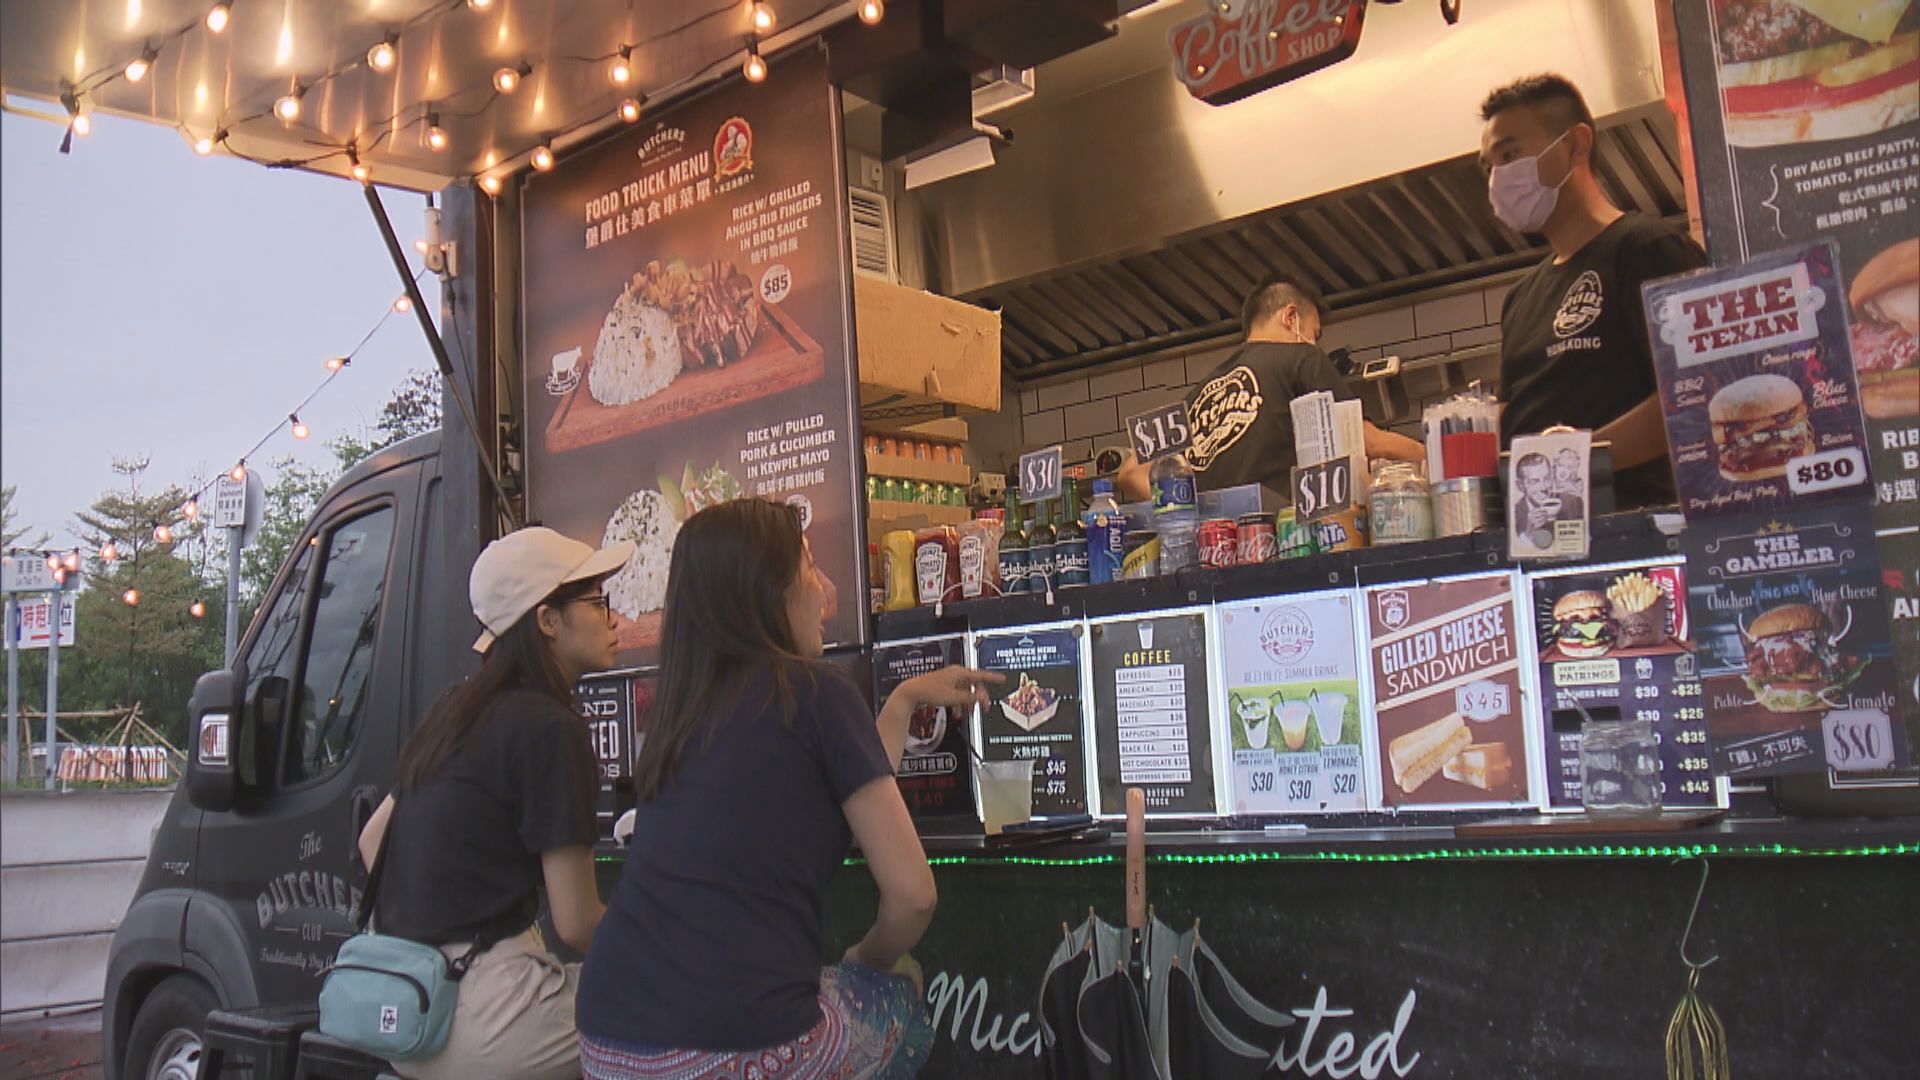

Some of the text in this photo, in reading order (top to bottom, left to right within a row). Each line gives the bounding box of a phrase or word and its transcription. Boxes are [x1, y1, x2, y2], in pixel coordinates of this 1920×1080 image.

[1183, 0, 1353, 86] Coffee
[1287, 28, 1340, 60] SHOP
[637, 127, 686, 160] BUTCHERS
[1784, 138, 1919, 179] DRY AGED BEEF PATTY,
[1795, 171, 1852, 193] TOMATO,
[1854, 157, 1908, 179] PICKLES
[586, 191, 620, 224] FOOD
[622, 170, 666, 208] TRUCK
[669, 150, 709, 188] MENU
[733, 202, 755, 221] RICE
[755, 195, 768, 211] W/
[769, 180, 811, 206] GRILLED
[726, 194, 822, 241] ANGUS RIB FINGERS
[740, 237, 751, 252] IN
[752, 228, 775, 247] BBQ
[777, 216, 808, 237] SAUCE
[764, 274, 788, 297] $85
[1682, 276, 1797, 331] THE
[1688, 312, 1800, 353] TEXAN
[1674, 376, 1704, 393] BBQ
[1812, 378, 1847, 397] Blue
[1191, 390, 1263, 437] UTCHERS
[747, 414, 824, 445] RICE W/ PULLED
[1133, 410, 1188, 460] $15
[1821, 433, 1853, 446] Bacon
[740, 430, 836, 463] PORK & CUCUMBER
[747, 449, 830, 479] IN KEWPIE MAYO
[1797, 458, 1855, 485] $80
[1025, 456, 1057, 496] $30
[1298, 465, 1348, 520] $10
[1318, 523, 1347, 546] NTA
[1754, 535, 1799, 554] THE
[1726, 547, 1835, 573] GAMBLER
[1707, 590, 1753, 611] Chicken
[1811, 586, 1837, 604] Blue
[1839, 584, 1878, 601] Cheese
[1259, 624, 1315, 644] BUTCHERS
[1381, 606, 1506, 675] GILLED CHEESE
[905, 657, 924, 666] TRUCK
[925, 655, 944, 664] MENU
[996, 645, 1057, 658] FOOD TRUCK MENU
[1124, 649, 1171, 667] COFFEE
[1118, 670, 1151, 681] ESPRESSO
[1285, 664, 1314, 680] SUMMER
[1314, 664, 1339, 677] DRINKS
[1387, 636, 1510, 696] SANDWICH
[1559, 670, 1616, 681] PAIRINGS
[1119, 685, 1154, 695] AMERICANO
[1597, 688, 1619, 697] FRIES
[1635, 688, 1659, 699] $30
[1672, 684, 1702, 696] +$25
[582, 701, 618, 717] ND
[1119, 700, 1155, 709] MACCHIATO
[1713, 690, 1895, 712] Pickle Tomato
[1120, 715, 1138, 724] LATTE
[1637, 709, 1704, 723] $30 +$25
[1121, 730, 1160, 738] CAPPUCCINO
[1675, 733, 1706, 745] +$35
[1833, 721, 1881, 764] $80
[1121, 745, 1141, 753] BLACK
[1046, 760, 1066, 776] $45
[1122, 761, 1135, 769] HOT
[1136, 758, 1172, 767] CHOCOLATE
[1323, 756, 1359, 769] LEMONADE
[1677, 759, 1709, 772] +$35
[1046, 780, 1066, 797] $75
[1146, 787, 1185, 798] BUTCHERS
[1251, 771, 1357, 802] $30 $30 $20
[1680, 783, 1710, 795] +$45
[1145, 797, 1170, 807] TRUCK
[299, 831, 322, 861] The
[302, 923, 322, 941] CLUB
